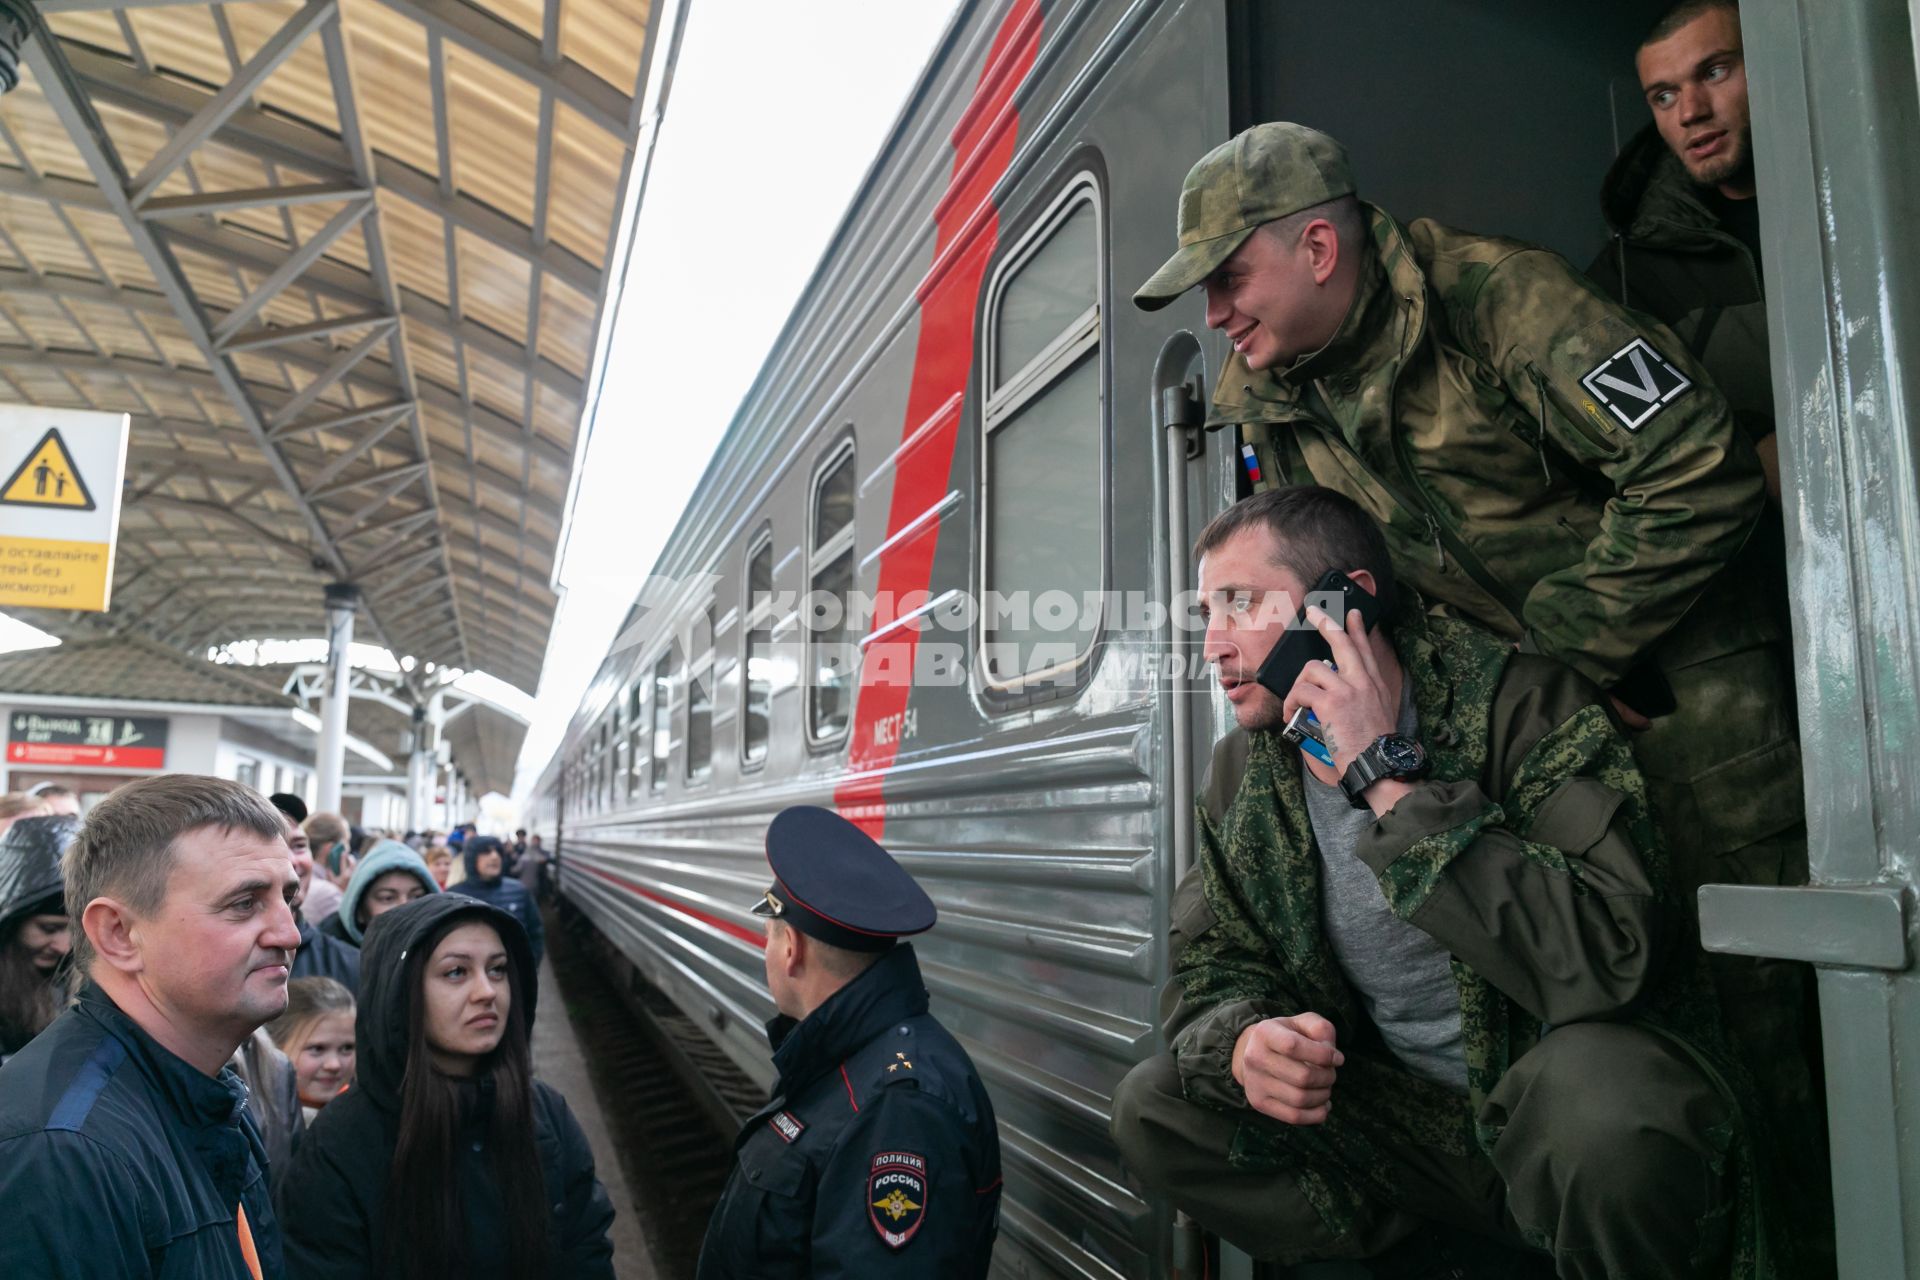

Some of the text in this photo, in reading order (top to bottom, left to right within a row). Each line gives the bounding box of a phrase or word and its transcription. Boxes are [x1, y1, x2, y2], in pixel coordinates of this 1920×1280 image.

[1595, 348, 1661, 403] V
[8, 547, 99, 561] оставляйте
[32, 563, 61, 577] без
[875, 1154, 922, 1169] ПОЛИЦИЯ
[875, 1174, 921, 1192] РОССИЯ
[885, 1230, 906, 1246] МВД
